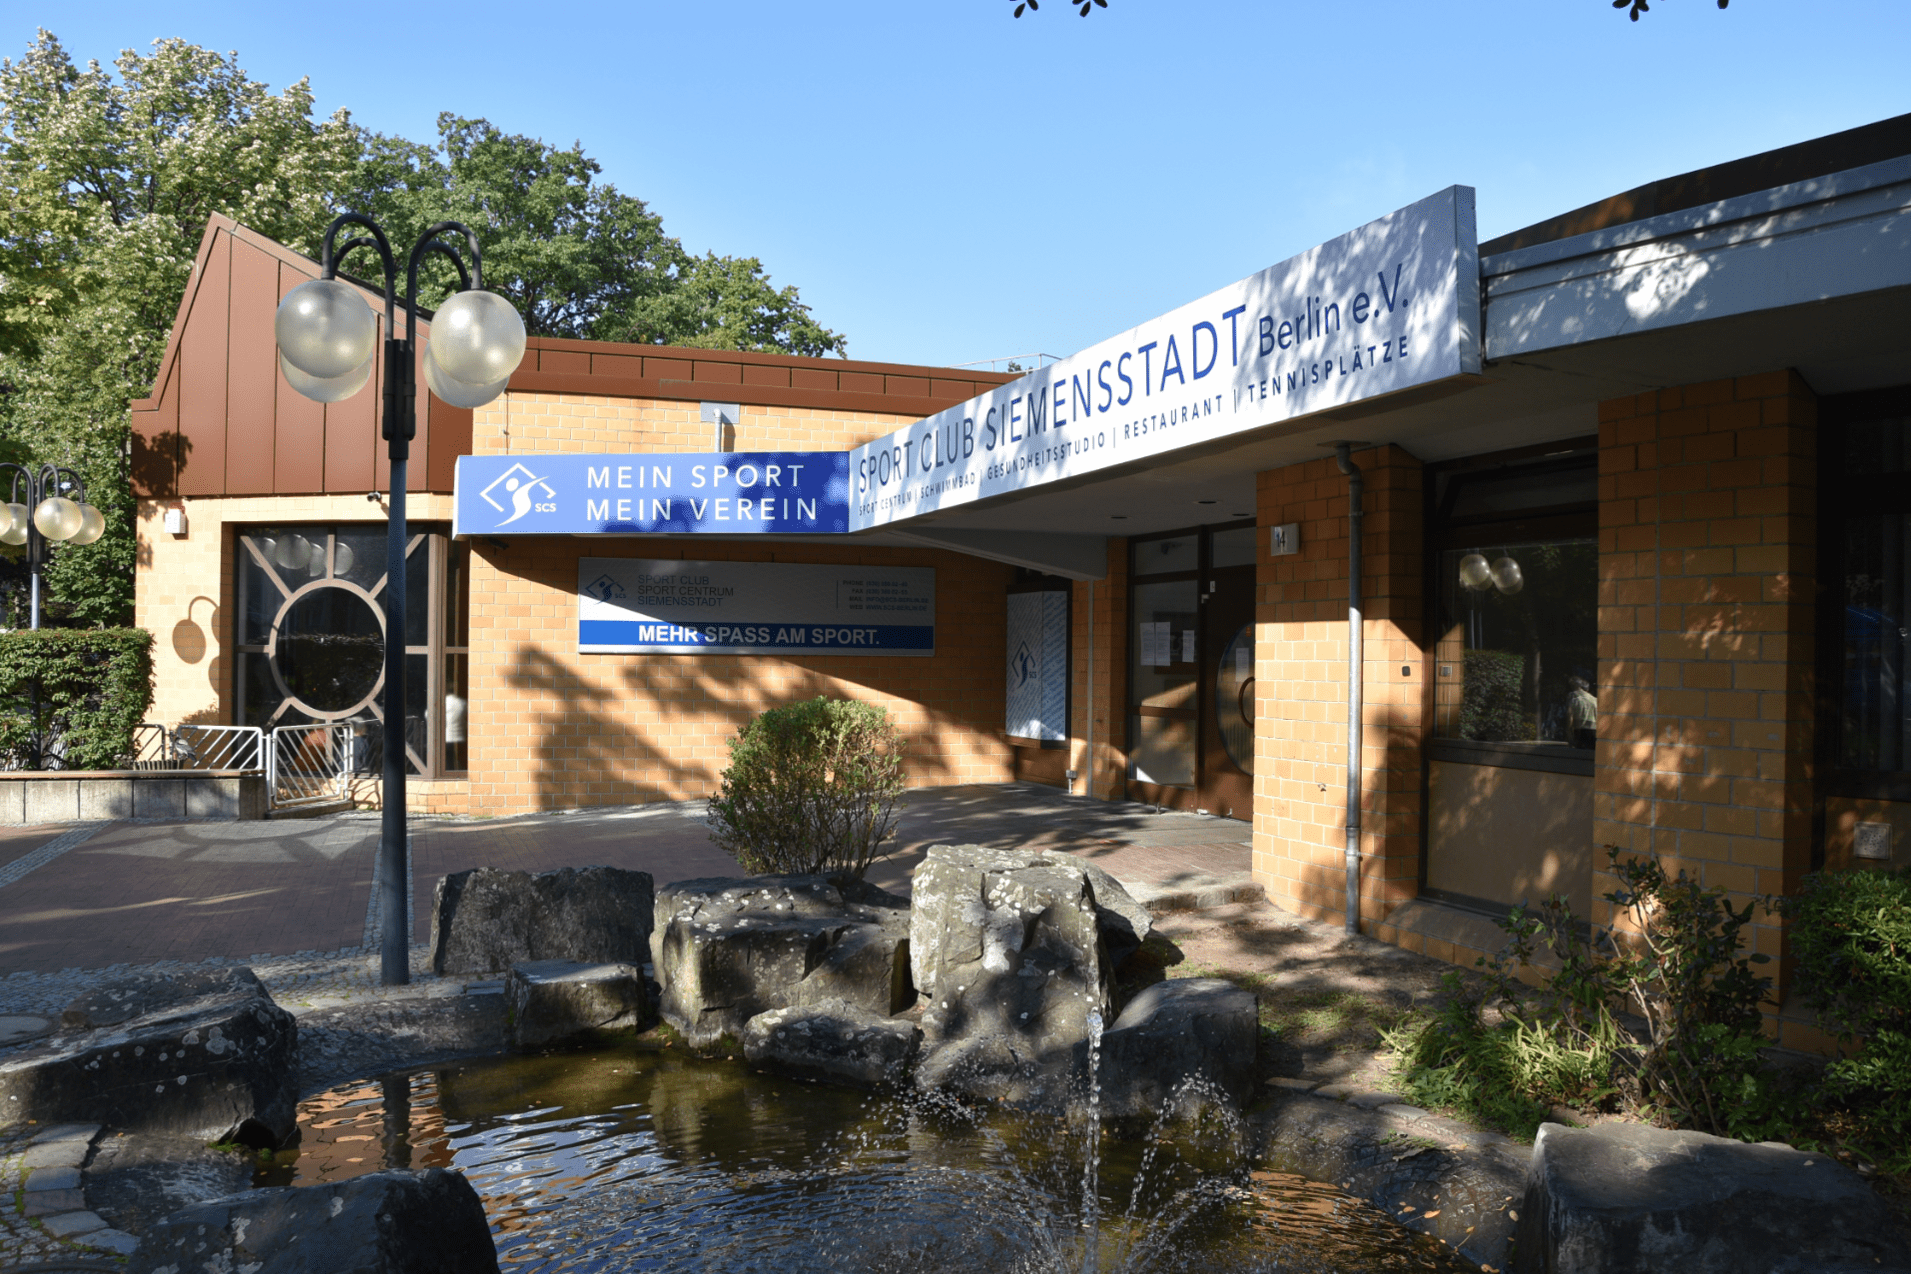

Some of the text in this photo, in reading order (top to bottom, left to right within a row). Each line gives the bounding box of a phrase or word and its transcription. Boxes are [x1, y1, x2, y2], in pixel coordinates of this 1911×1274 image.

[859, 263, 1409, 494] SPORT CLUB SIEMENSSTADT Berlin e.V.
[859, 335, 1408, 516] SPORT CENTRUM SCHWIMMBAD GESUNDHEITSSTUDIO RESTAURANT TENNISPLÄTZE
[587, 465, 804, 488] MEIN SPORT
[535, 503, 557, 513] SCS
[587, 498, 817, 521] MEIN VEREIN
[1276, 531, 1286, 547] 14
[638, 574, 709, 585] SPORT CLUB
[638, 585, 734, 597] SPORT CENTRUM
[638, 596, 723, 607] SIEMENSSTADT
[639, 625, 880, 645] MEHR SPASS AM SPORT.
